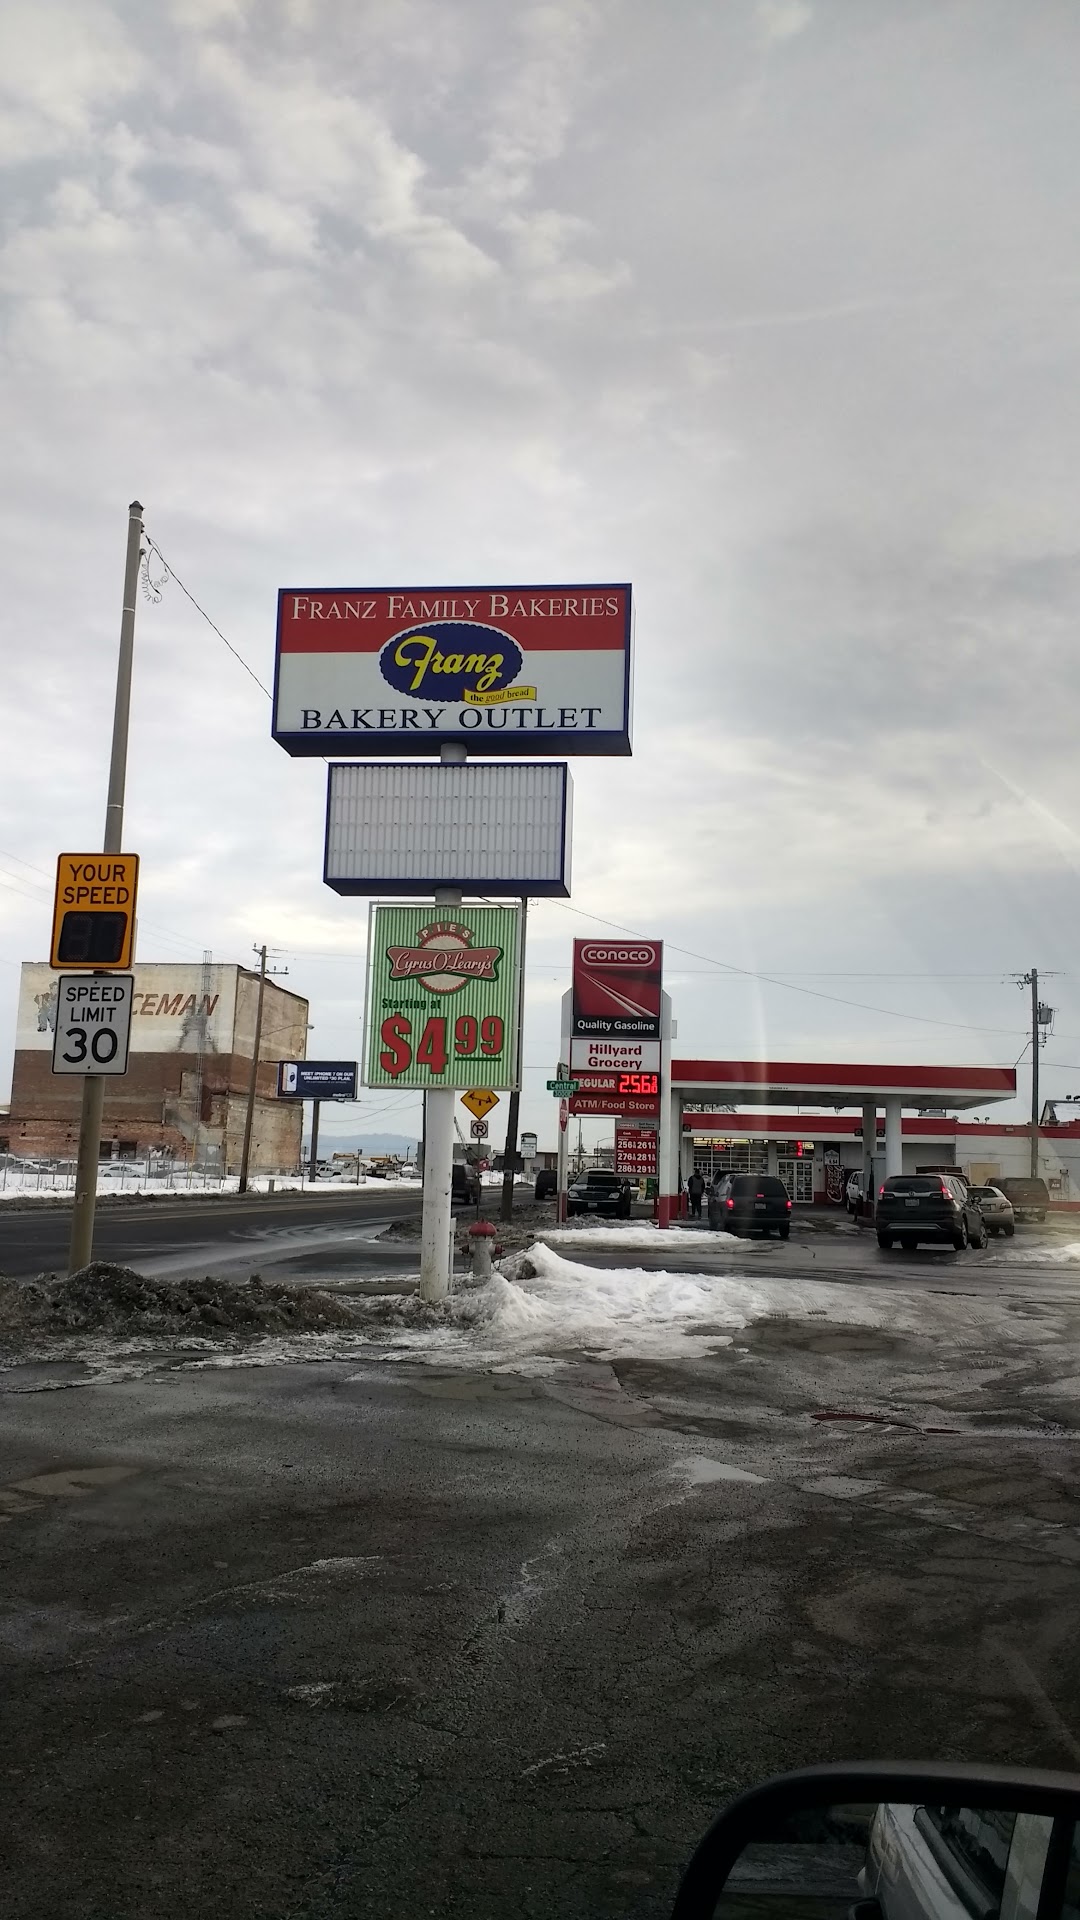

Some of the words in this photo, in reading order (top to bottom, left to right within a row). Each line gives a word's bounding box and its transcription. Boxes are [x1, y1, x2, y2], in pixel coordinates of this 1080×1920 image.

[291, 596, 377, 620] FRANZ
[387, 595, 480, 619] FAMILY
[489, 594, 619, 617] BAKERIES
[394, 635, 505, 691] Franz
[470, 692, 484, 702] the
[485, 691, 505, 703] good
[506, 688, 530, 698] bread
[300, 708, 447, 730] BAKERY
[458, 707, 602, 729] OUTLET
[69, 864, 126, 882] YOUR
[62, 886, 130, 904] SPEED
[421, 923, 471, 939] PIES
[395, 952, 433, 975] Cyrus
[432, 951, 492, 976] O'Leary's
[65, 986, 125, 1002] SPEED
[381, 998, 427, 1010] Starting
[430, 998, 442, 1009] at
[70, 1007, 117, 1023] LIMIT
[577, 1020, 612, 1032] Quality
[614, 1020, 655, 1031] Gasoline
[62, 1027, 118, 1063] 30
[589, 1044, 643, 1058] Hillyard
[588, 1057, 643, 1071] Grocery
[550, 1081, 577, 1090] Central
[574, 1100, 626, 1109] ATM/Food
[628, 1101, 655, 1110] Store
